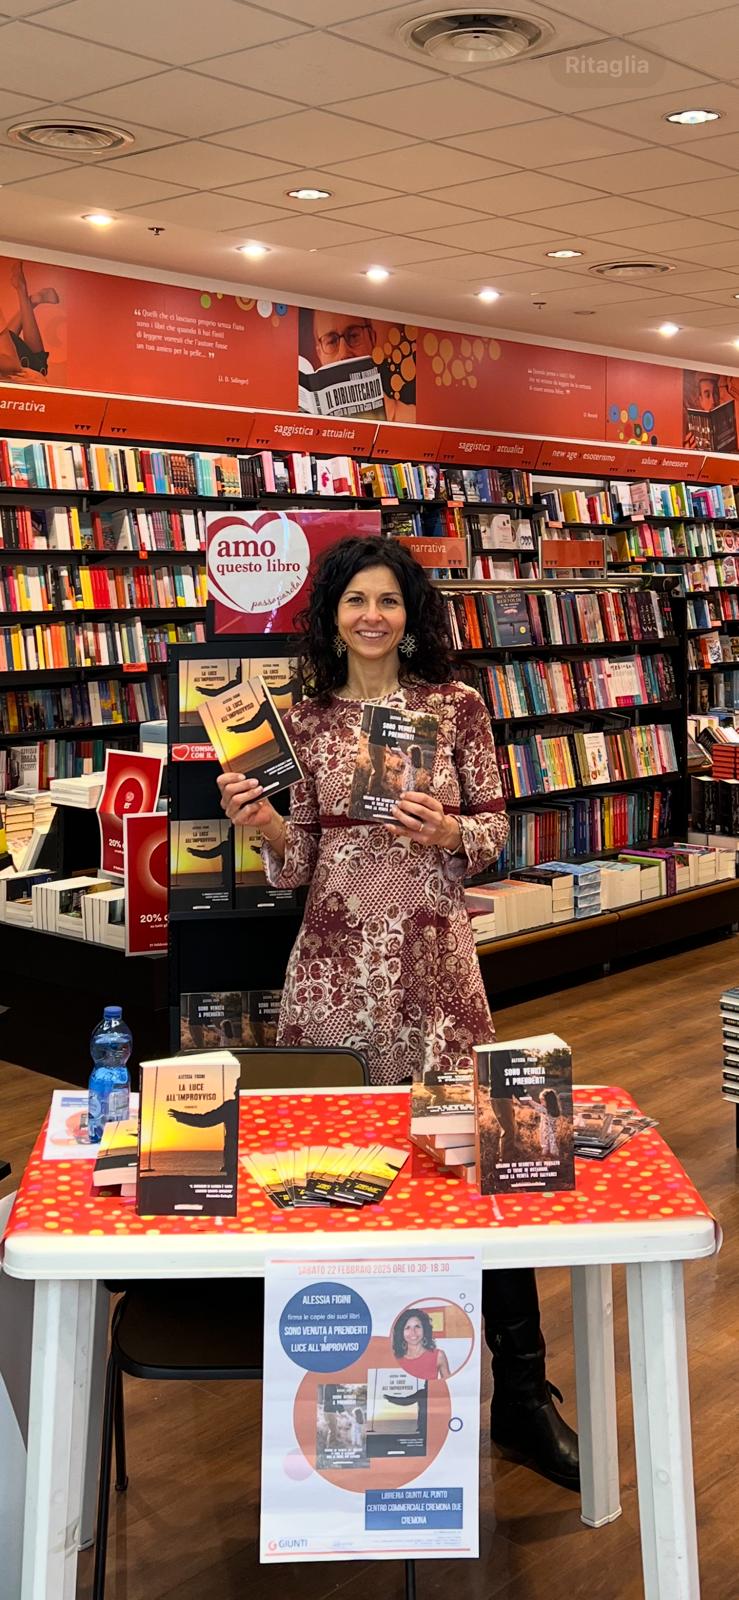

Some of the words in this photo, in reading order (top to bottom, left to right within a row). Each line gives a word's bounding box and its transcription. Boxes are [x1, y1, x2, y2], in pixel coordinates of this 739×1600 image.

[177, 326, 196, 334] quando
[144, 332, 163, 342] leggere
[326, 391, 333, 409] IL
[333, 379, 381, 406] BIBLIOTECARIO
[274, 424, 313, 437] saggistica
[322, 429, 355, 439] attualità
[458, 442, 490, 452] saggistica
[566, 451, 578, 461] age
[583, 452, 615, 462] esoterismo
[641, 456, 657, 465] salute
[662, 459, 688, 468] benessere
[217, 539, 276, 557] amo
[411, 542, 447, 553] narrativa
[216, 562, 262, 576] questo
[267, 559, 300, 572] libro
[232, 700, 243, 709] LUCE
[109, 839, 121, 848] 20%
[140, 914, 162, 923] 20%
[504, 1068, 520, 1076] SONO
[523, 1067, 545, 1075] VENUTA
[513, 1076, 545, 1085] PRENDERTI
[166, 1093, 216, 1101] ALL'IMPROVVISO
[298, 1265, 325, 1275] SABATO
[328, 1265, 336, 1274] 22
[338, 1264, 370, 1274] FEBBRAIO
[373, 1264, 391, 1273] 2025
[393, 1264, 405, 1273] ORE
[302, 1296, 330, 1304] ALESSIA
[332, 1295, 351, 1304] FIGINI
[284, 1326, 301, 1335] SONO
[302, 1326, 327, 1335] VENUTA
[328, 1326, 332, 1335] A
[334, 1326, 368, 1334] PRENDERTI
[291, 1344, 307, 1352] LUCE
[401, 1516, 427, 1524] CREMONA
[278, 1539, 308, 1548] GIUNTI
